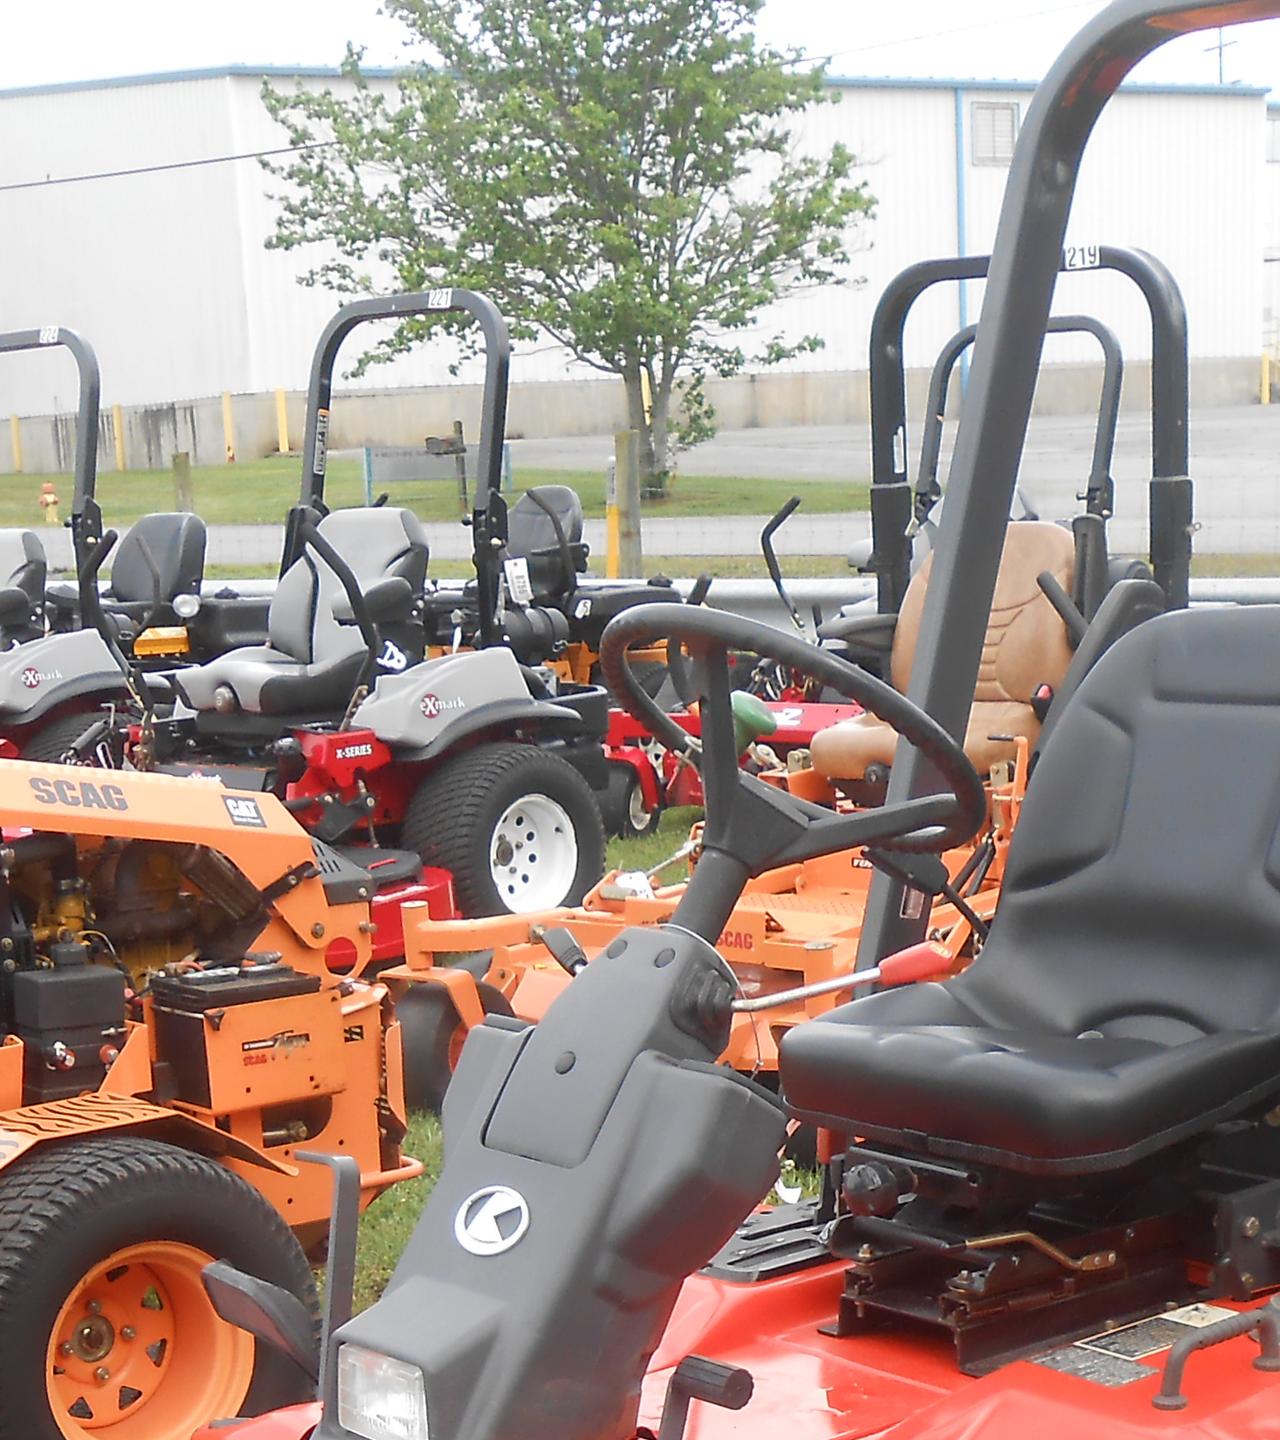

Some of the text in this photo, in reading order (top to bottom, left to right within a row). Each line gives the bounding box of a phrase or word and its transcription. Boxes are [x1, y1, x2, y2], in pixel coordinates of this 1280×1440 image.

[1067, 245, 1097, 267] 219
[430, 290, 450, 306] 221
[335, 744, 372, 760] X-SERIES
[28, 776, 129, 812] SCAG
[224, 799, 259, 818] CAT
